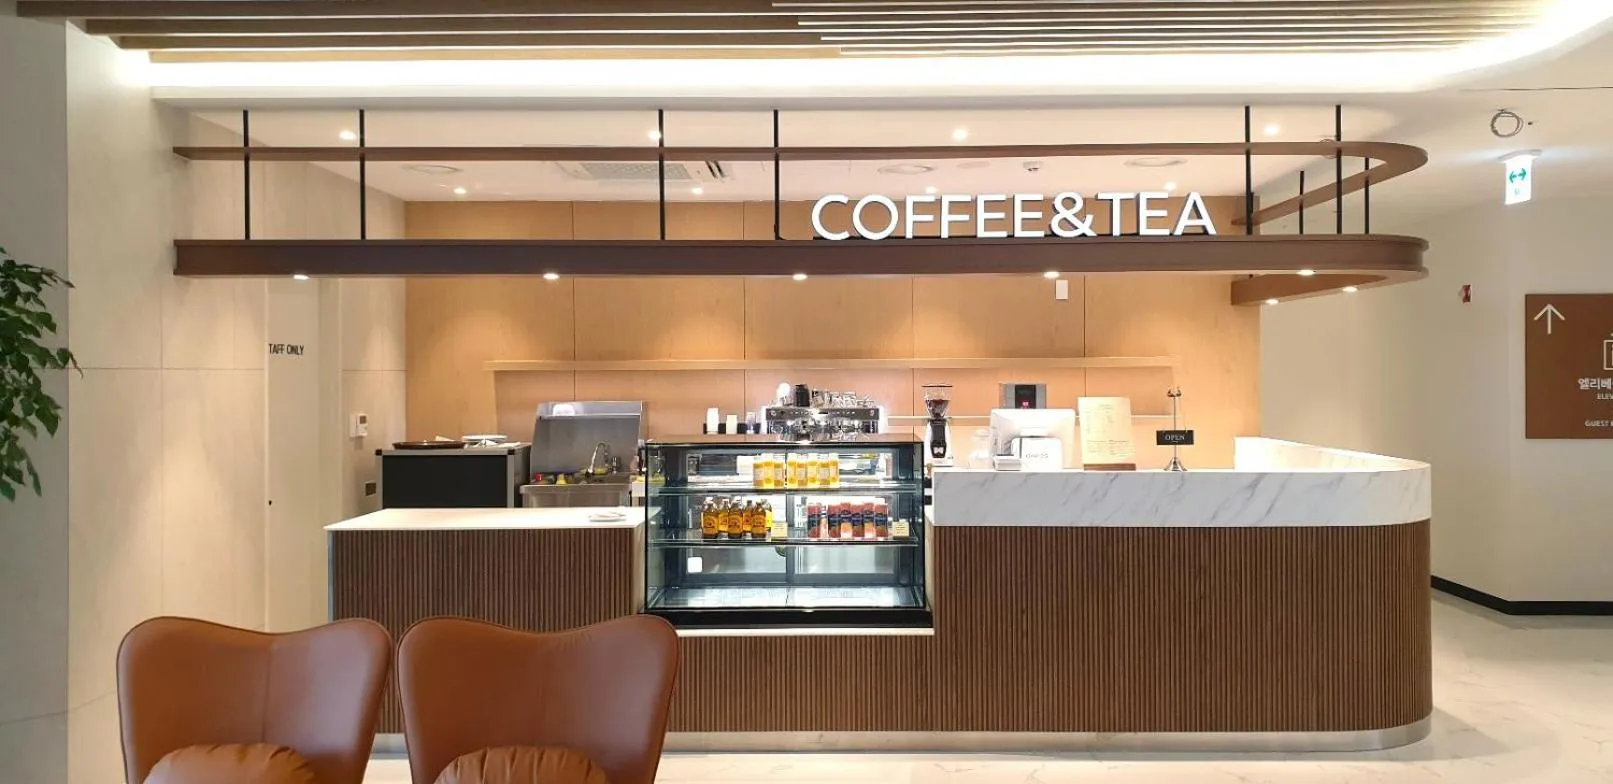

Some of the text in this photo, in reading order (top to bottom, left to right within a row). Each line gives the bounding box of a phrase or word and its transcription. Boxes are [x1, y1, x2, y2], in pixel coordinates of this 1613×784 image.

[811, 191, 1217, 240] COFFEE&TEA
[286, 344, 304, 355] ONLY
[1578, 377, 1613, 390] 엘리베
[1164, 433, 1185, 441] OPEN
